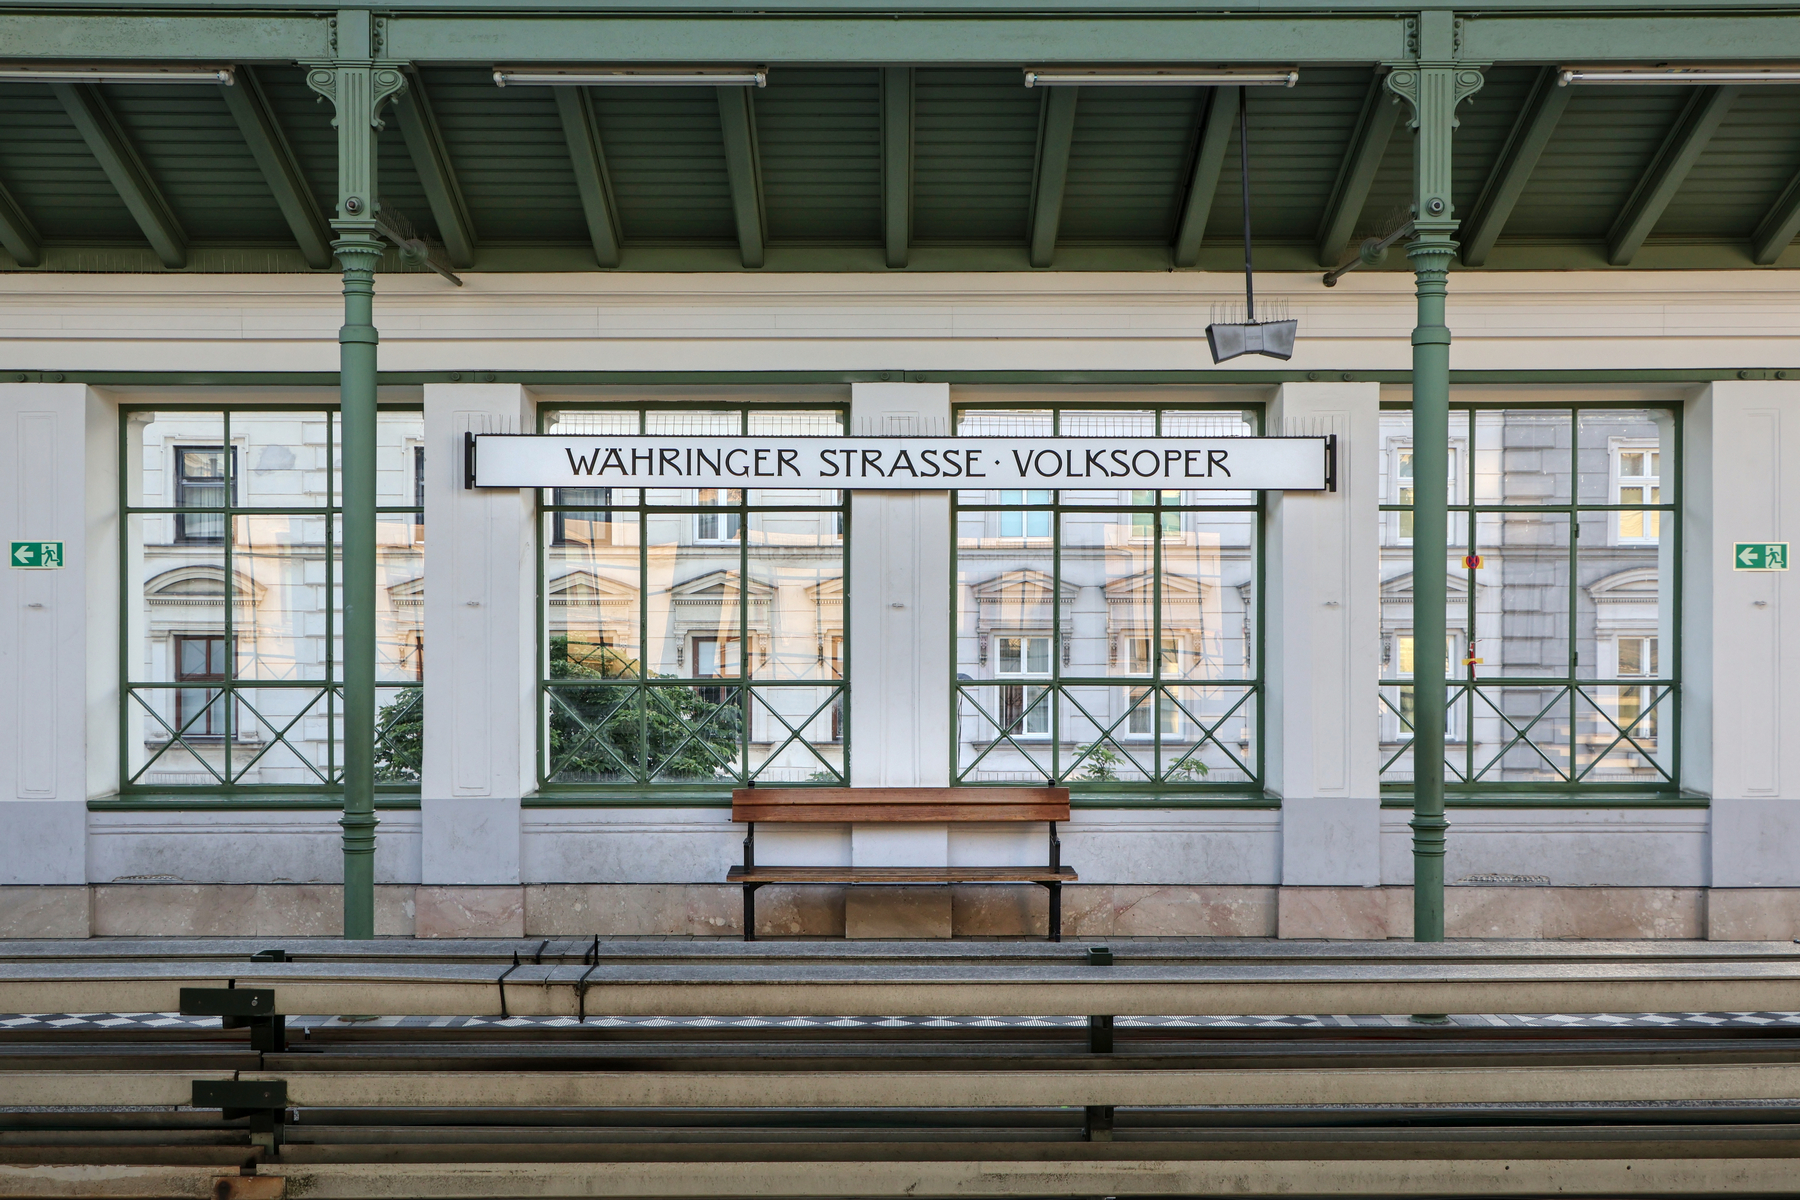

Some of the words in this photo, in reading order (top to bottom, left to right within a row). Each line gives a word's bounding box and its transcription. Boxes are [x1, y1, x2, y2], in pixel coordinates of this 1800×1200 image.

[564, 447, 801, 478] WÄHRINGER
[819, 449, 986, 478] STRASSE
[1011, 449, 1232, 478] VOLKSOPER
